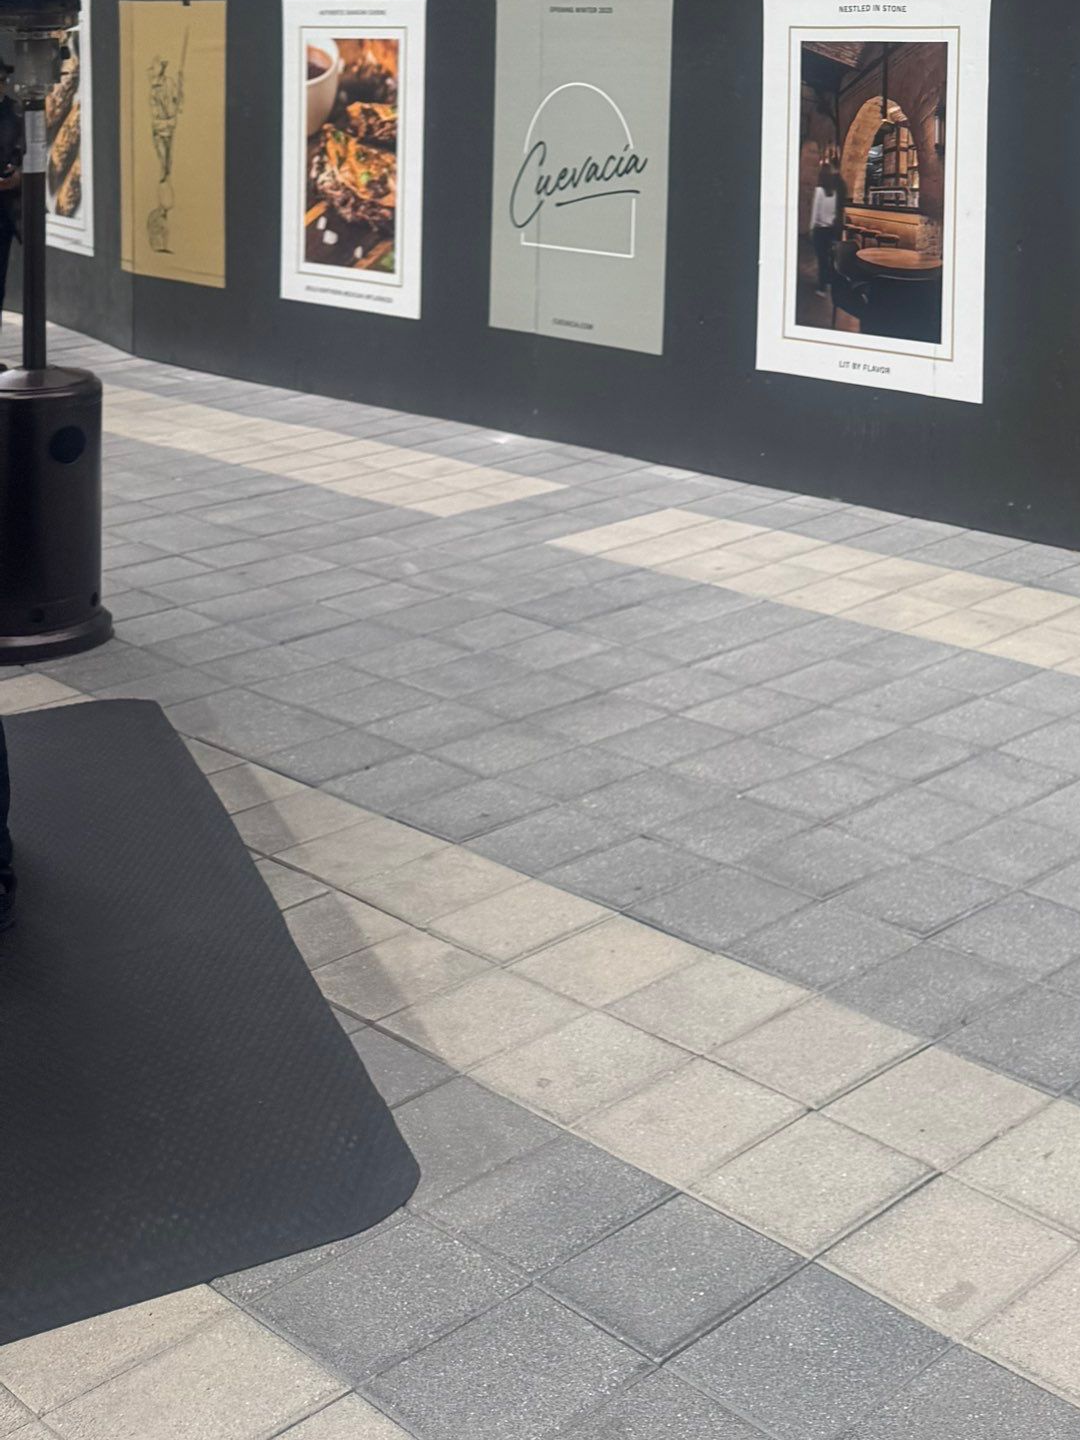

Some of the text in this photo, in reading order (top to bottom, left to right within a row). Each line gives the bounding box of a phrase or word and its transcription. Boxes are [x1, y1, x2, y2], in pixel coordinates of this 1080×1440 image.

[838, 4, 907, 13] NESTLED IN STONE
[838, 360, 891, 374] LIT BY FLAVOR
